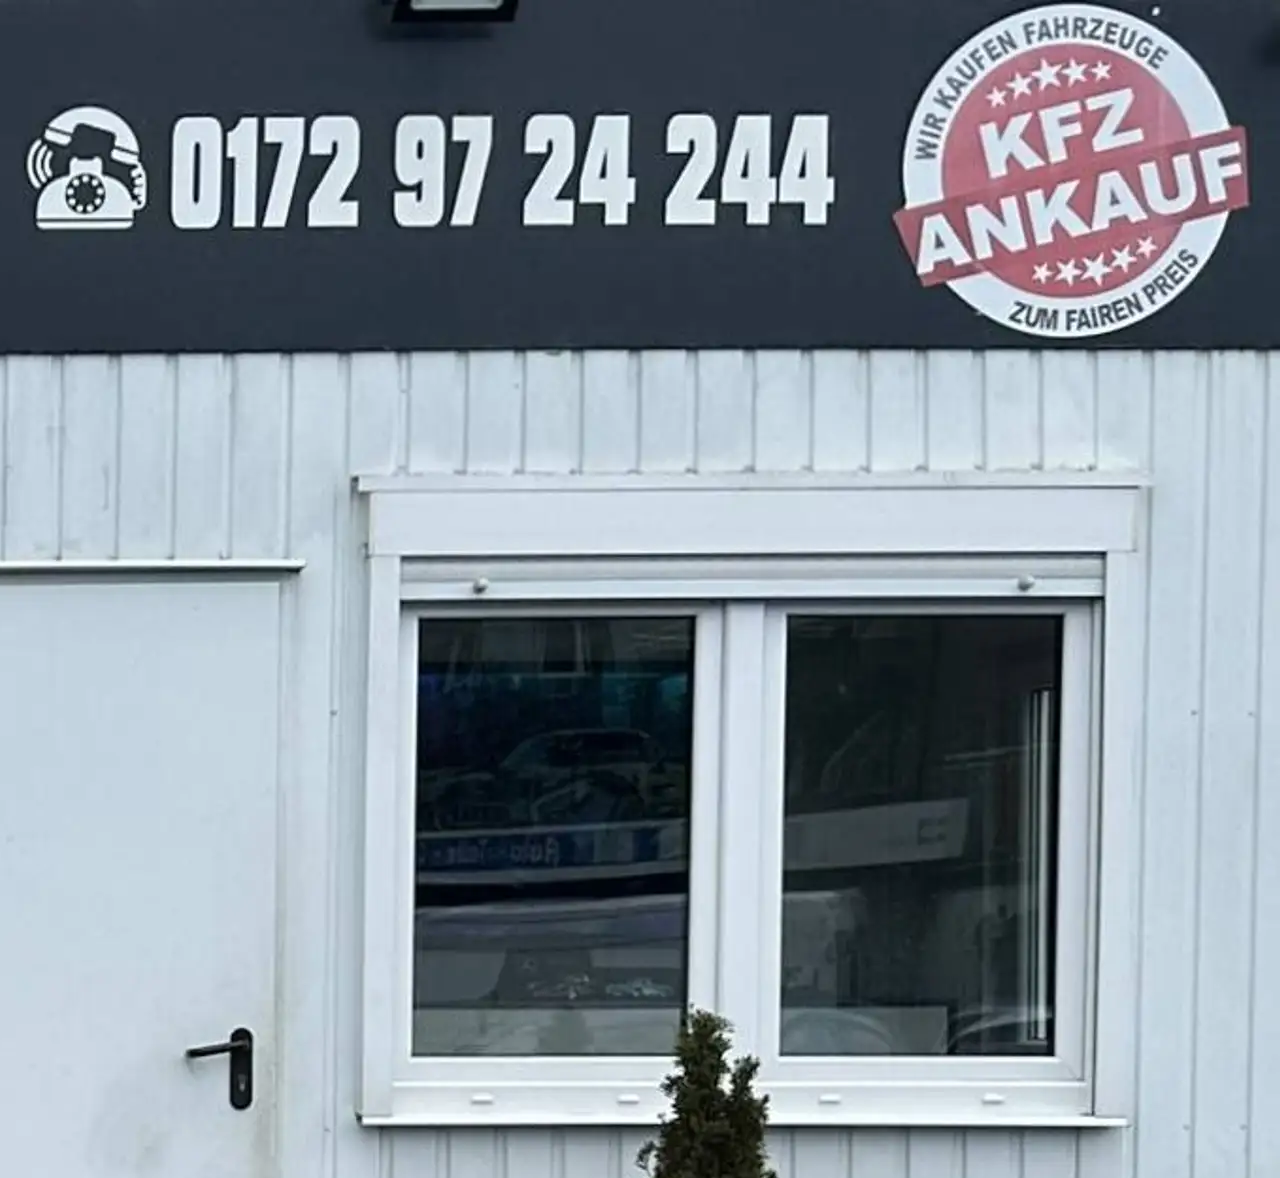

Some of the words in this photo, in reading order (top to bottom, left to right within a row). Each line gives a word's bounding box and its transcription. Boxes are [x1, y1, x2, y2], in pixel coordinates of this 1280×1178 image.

[915, 109, 947, 161] WIR
[934, 30, 1018, 111] KAUFEN
[1022, 16, 1169, 70] FAHRZEUGE
[979, 88, 1144, 180] KFZ
[170, 114, 361, 229] 0172
[393, 115, 494, 227] 97
[522, 113, 637, 226] 24
[663, 113, 836, 226] 244
[917, 142, 1242, 276] ANKAUF
[1008, 301, 1058, 331] ZUM
[1065, 293, 1144, 332] FAIREN
[1145, 249, 1200, 305] PREIS
